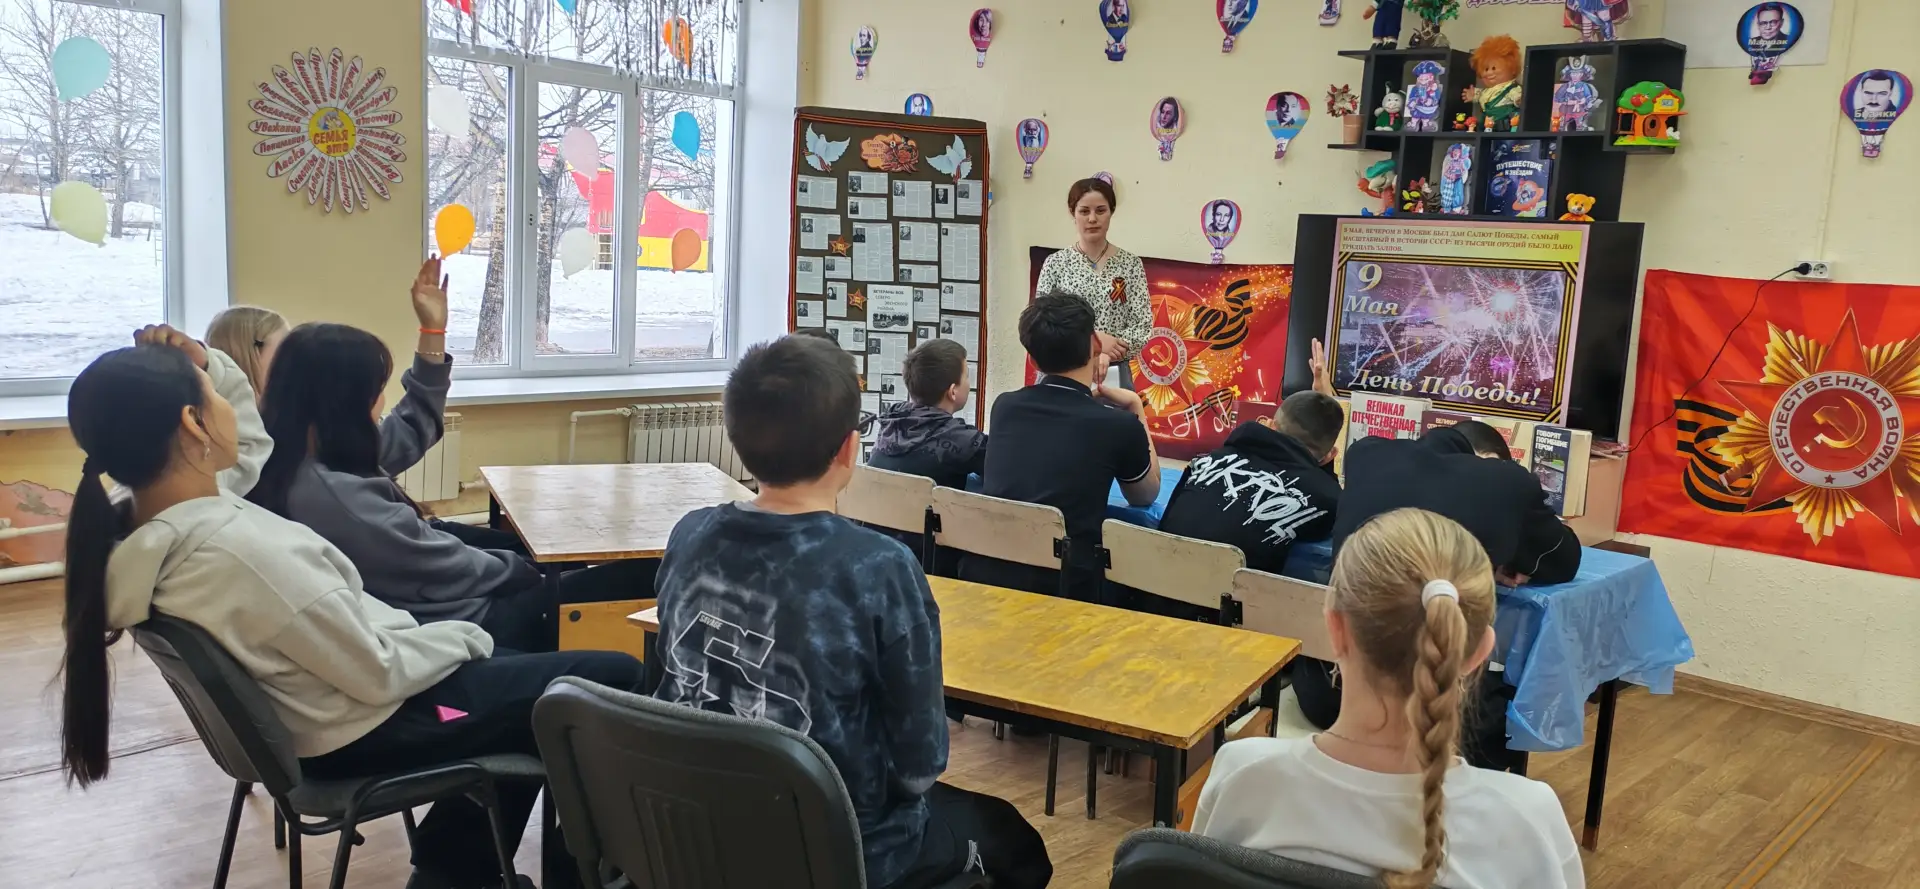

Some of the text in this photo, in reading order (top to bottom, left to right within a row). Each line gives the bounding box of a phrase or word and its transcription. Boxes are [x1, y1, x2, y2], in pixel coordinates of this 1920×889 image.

[275, 70, 310, 105] Забота
[255, 121, 301, 133] Уважение
[313, 129, 348, 145] СЕМЬЯ
[274, 147, 306, 176] Ласка
[1496, 160, 1543, 171] ПУТЕШЕСТВИЕ
[289, 154, 318, 190] Счастье
[1358, 263, 1383, 292] 9
[1343, 294, 1399, 316] Мая
[1348, 368, 1541, 406] День Победы!
[1366, 399, 1405, 417] ВЕЛИКАЯ
[1351, 410, 1416, 432] ОТЕЧЕСТВЕННАЯ
[1775, 375, 1893, 474] ОТЕЧЕСТВЕННАЯ
[1535, 437, 1568, 449] ПОГИБШИЕ
[1536, 429, 1562, 440] ГОВОРЯТ
[1535, 443, 1554, 452] ГЕРОИ
[698, 614, 723, 631] SAVAGE
